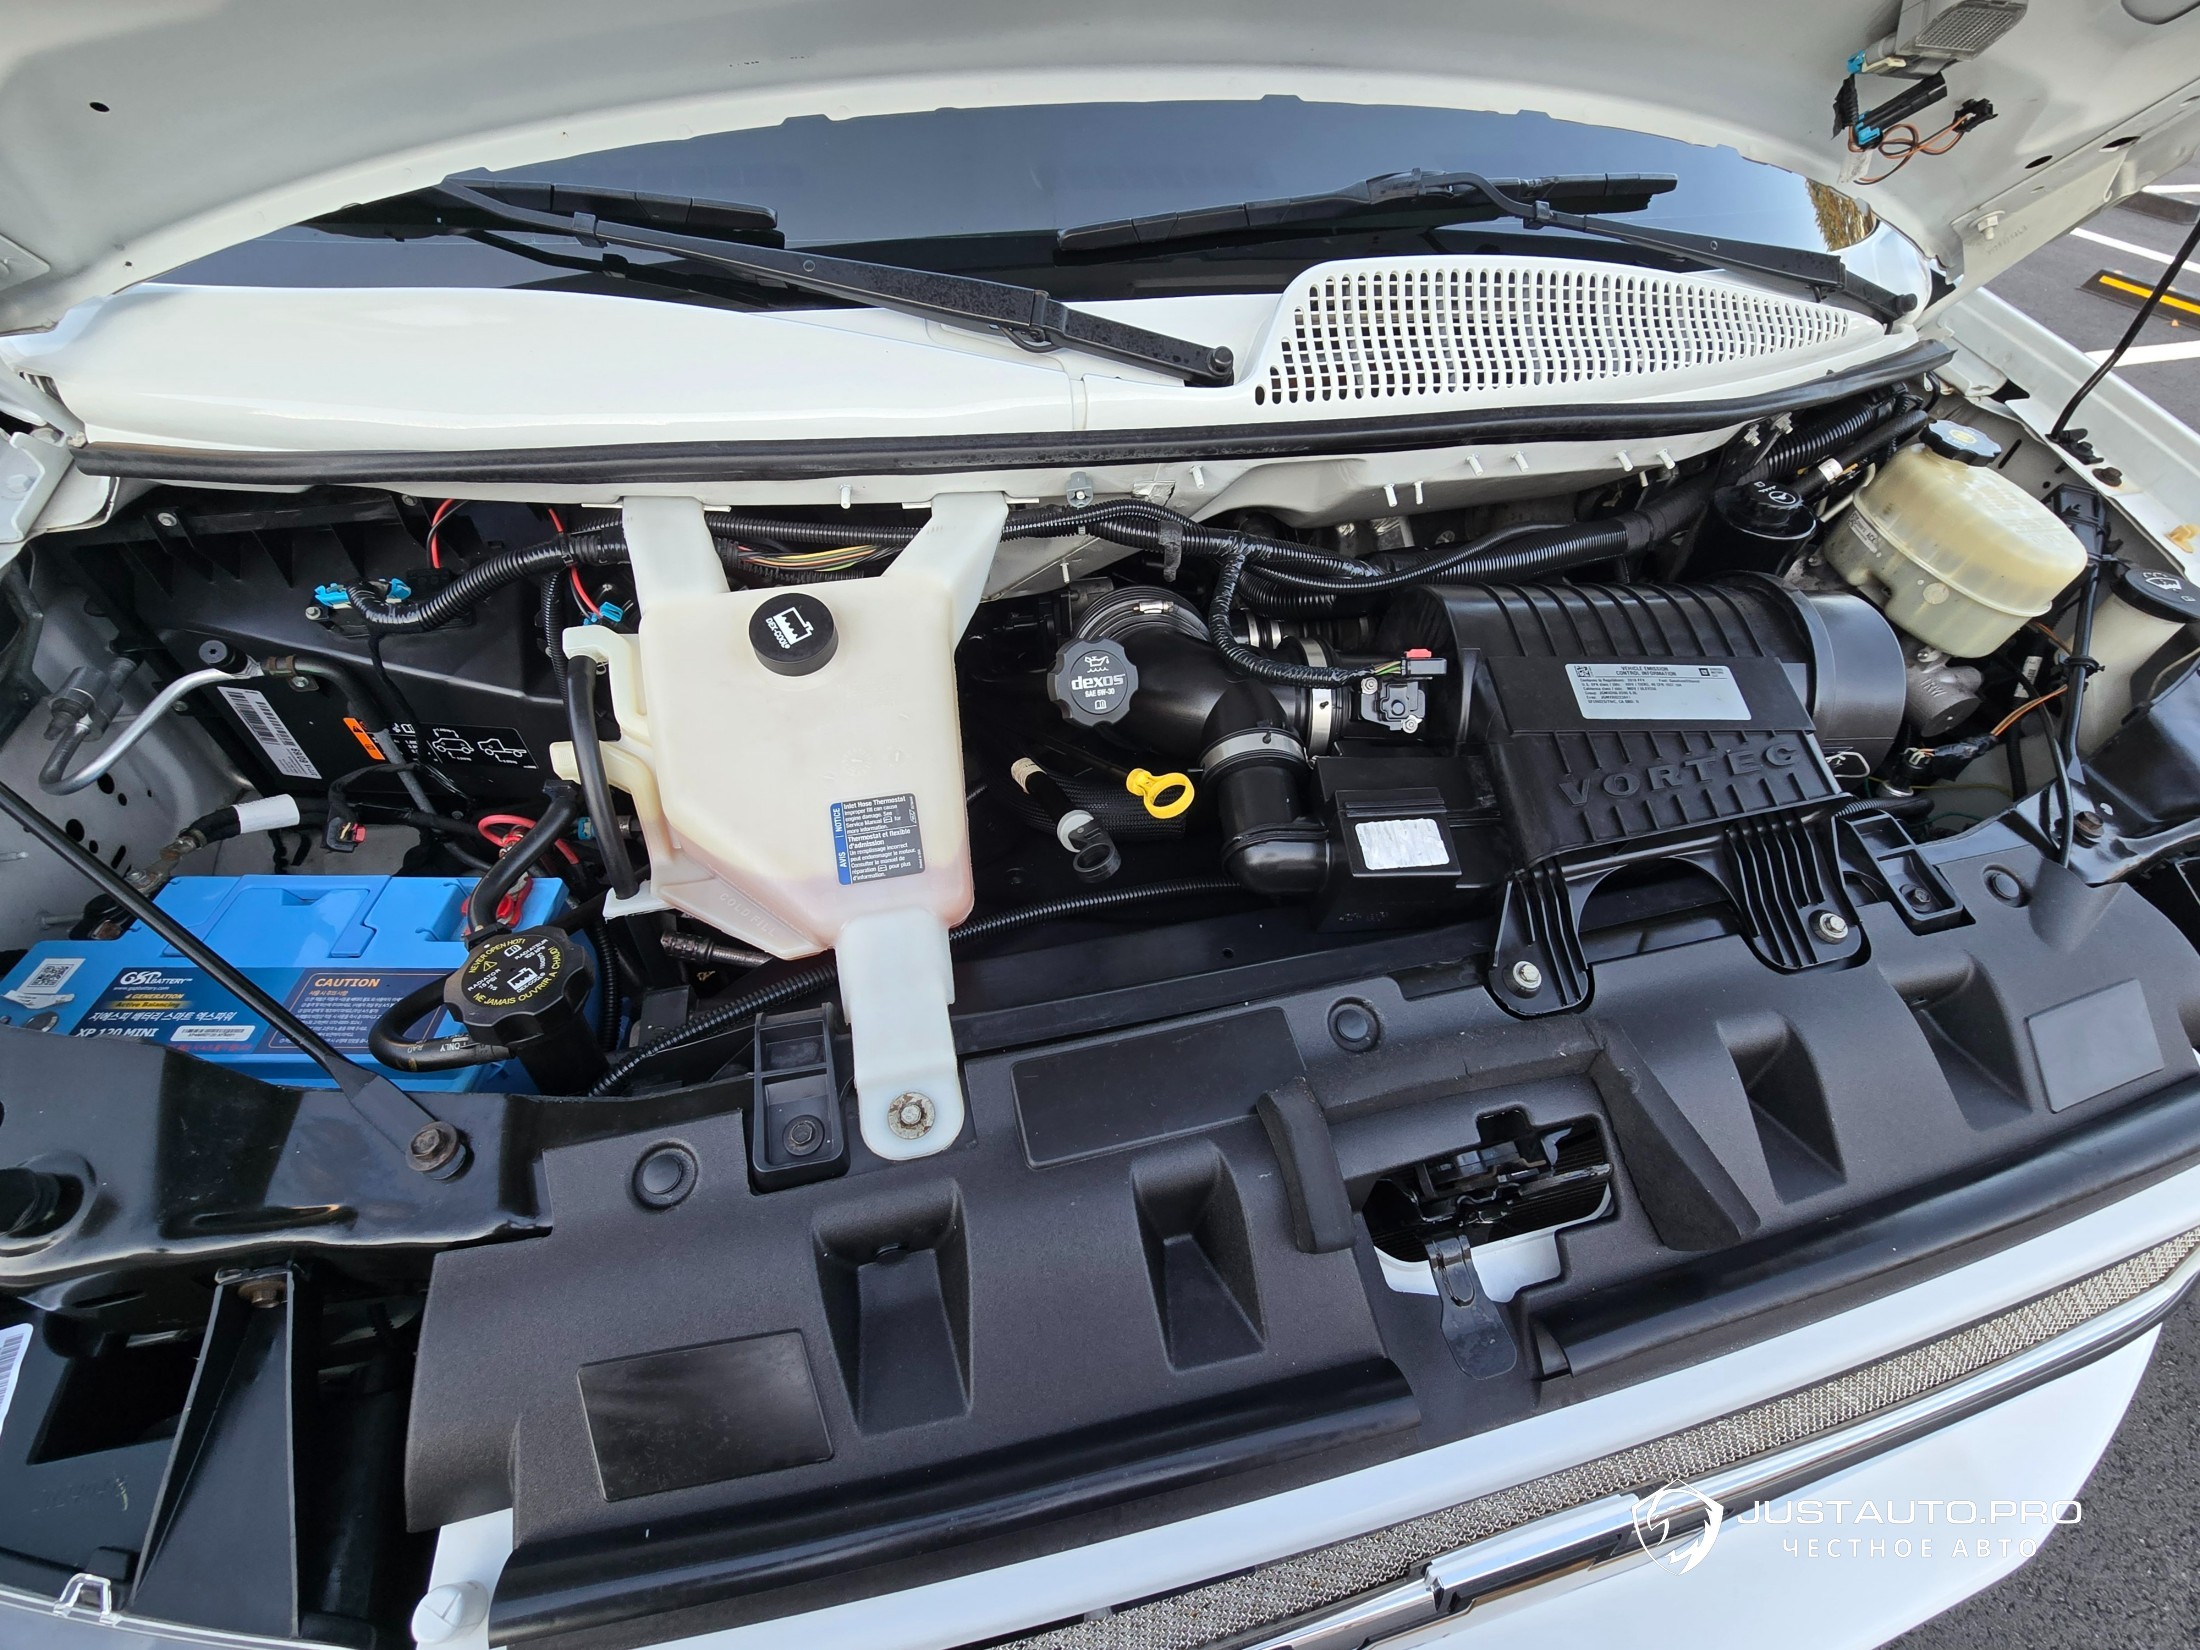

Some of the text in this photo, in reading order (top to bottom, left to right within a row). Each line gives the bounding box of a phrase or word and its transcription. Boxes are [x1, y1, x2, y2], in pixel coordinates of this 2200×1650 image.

[1071, 673, 1125, 690] dexos
[1085, 688, 1115, 698] SAE 5W-30
[1558, 742, 1802, 808] VORTEC
[873, 796, 906, 805] Thermostat
[833, 808, 843, 832] NOTICE
[848, 832, 881, 842] Thermostat
[839, 851, 848, 868] AVIS
[720, 892, 778, 937] COLD FILL
[468, 938, 526, 974] NEVER OPEN HOT!
[514, 939, 549, 960] RADIATEUR
[120, 971, 162, 985] GSP
[314, 978, 380, 988] CAUTION
[467, 968, 502, 991] RADIATOR
[473, 992, 487, 1003] NE
[484, 997, 517, 1006] JAMAIS
[519, 978, 552, 1001] OUVRIR
[547, 946, 561, 970] CHAUD!
[142, 1001, 180, 1009] Balancing
[131, 1011, 162, 1021] 배터리
[161, 1011, 194, 1021] 스마트
[76, 1028, 97, 1037] XP
[122, 1028, 159, 1037] MINI
[440, 1042, 461, 1052] ONLY
